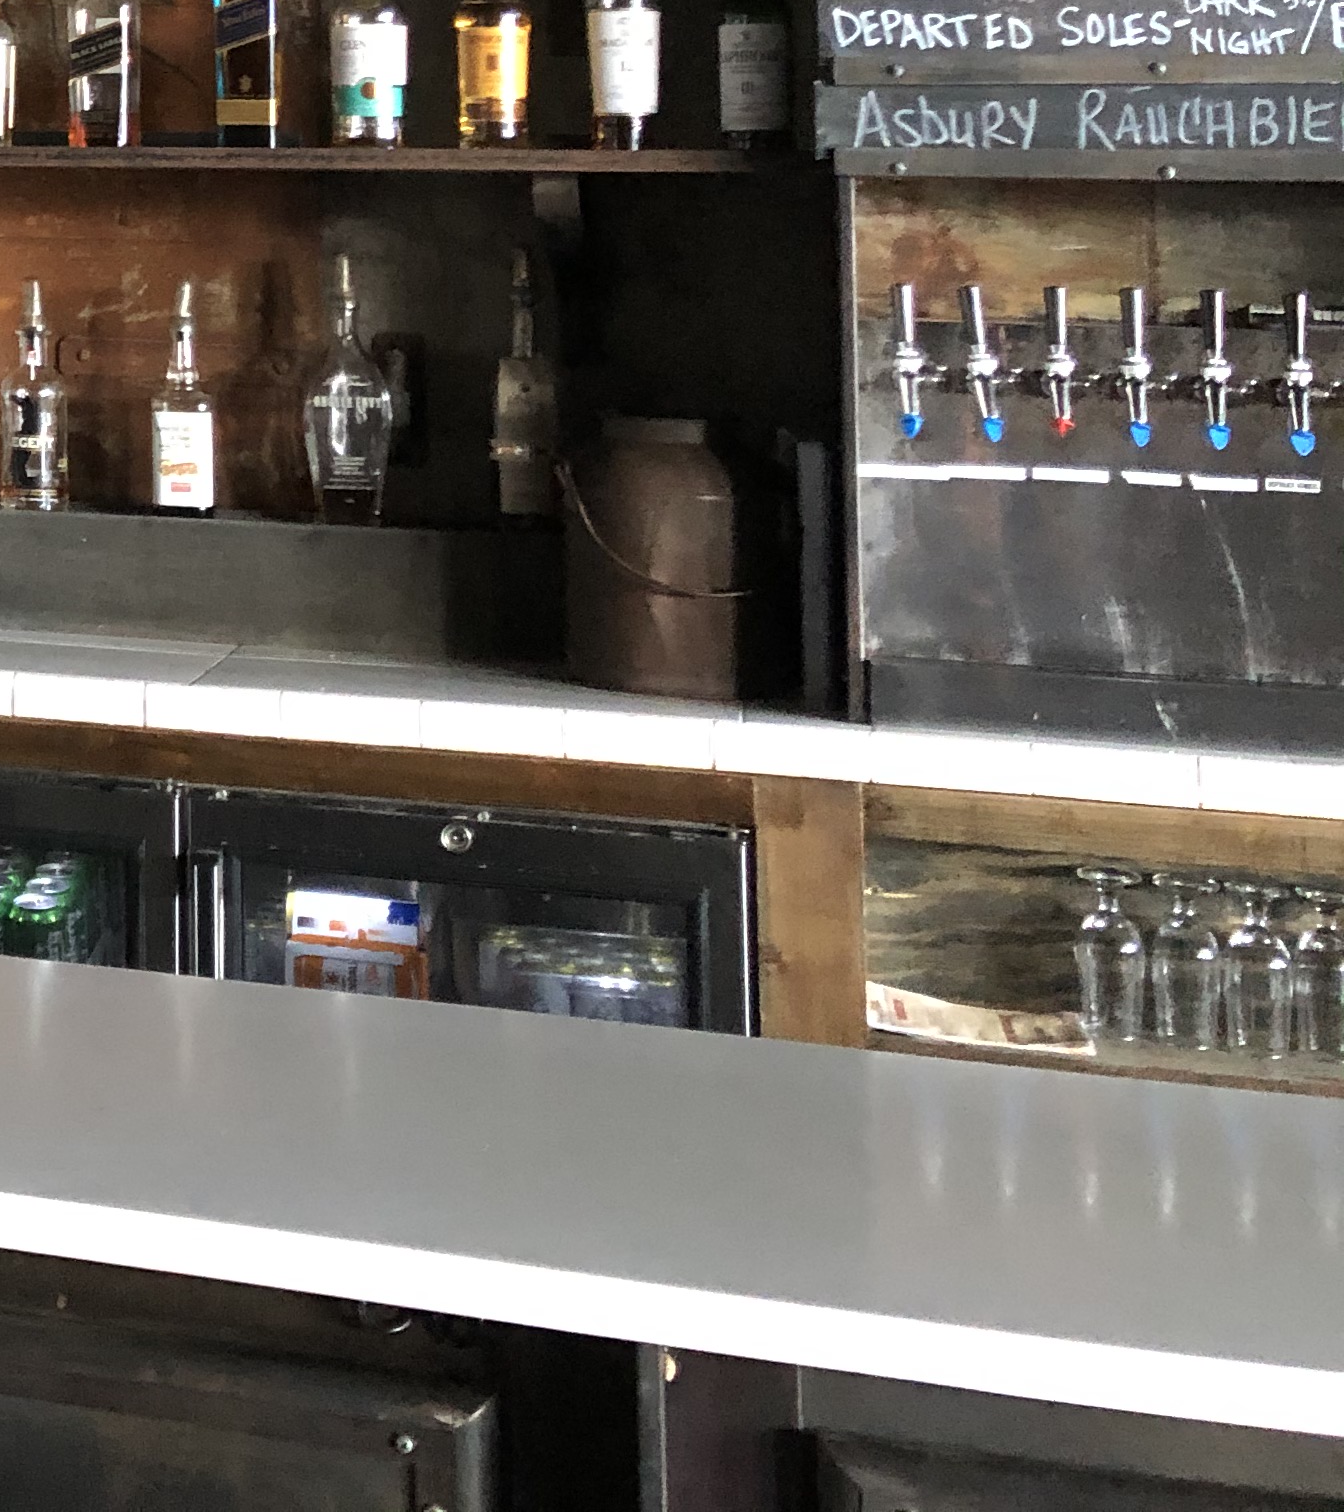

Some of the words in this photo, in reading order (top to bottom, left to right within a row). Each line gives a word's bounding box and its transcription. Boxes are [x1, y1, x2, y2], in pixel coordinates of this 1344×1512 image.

[832, 7, 1033, 50] DEPARTED
[1189, 27, 1296, 56] NIGHT
[1078, 88, 1344, 151] RAUCHBIE
